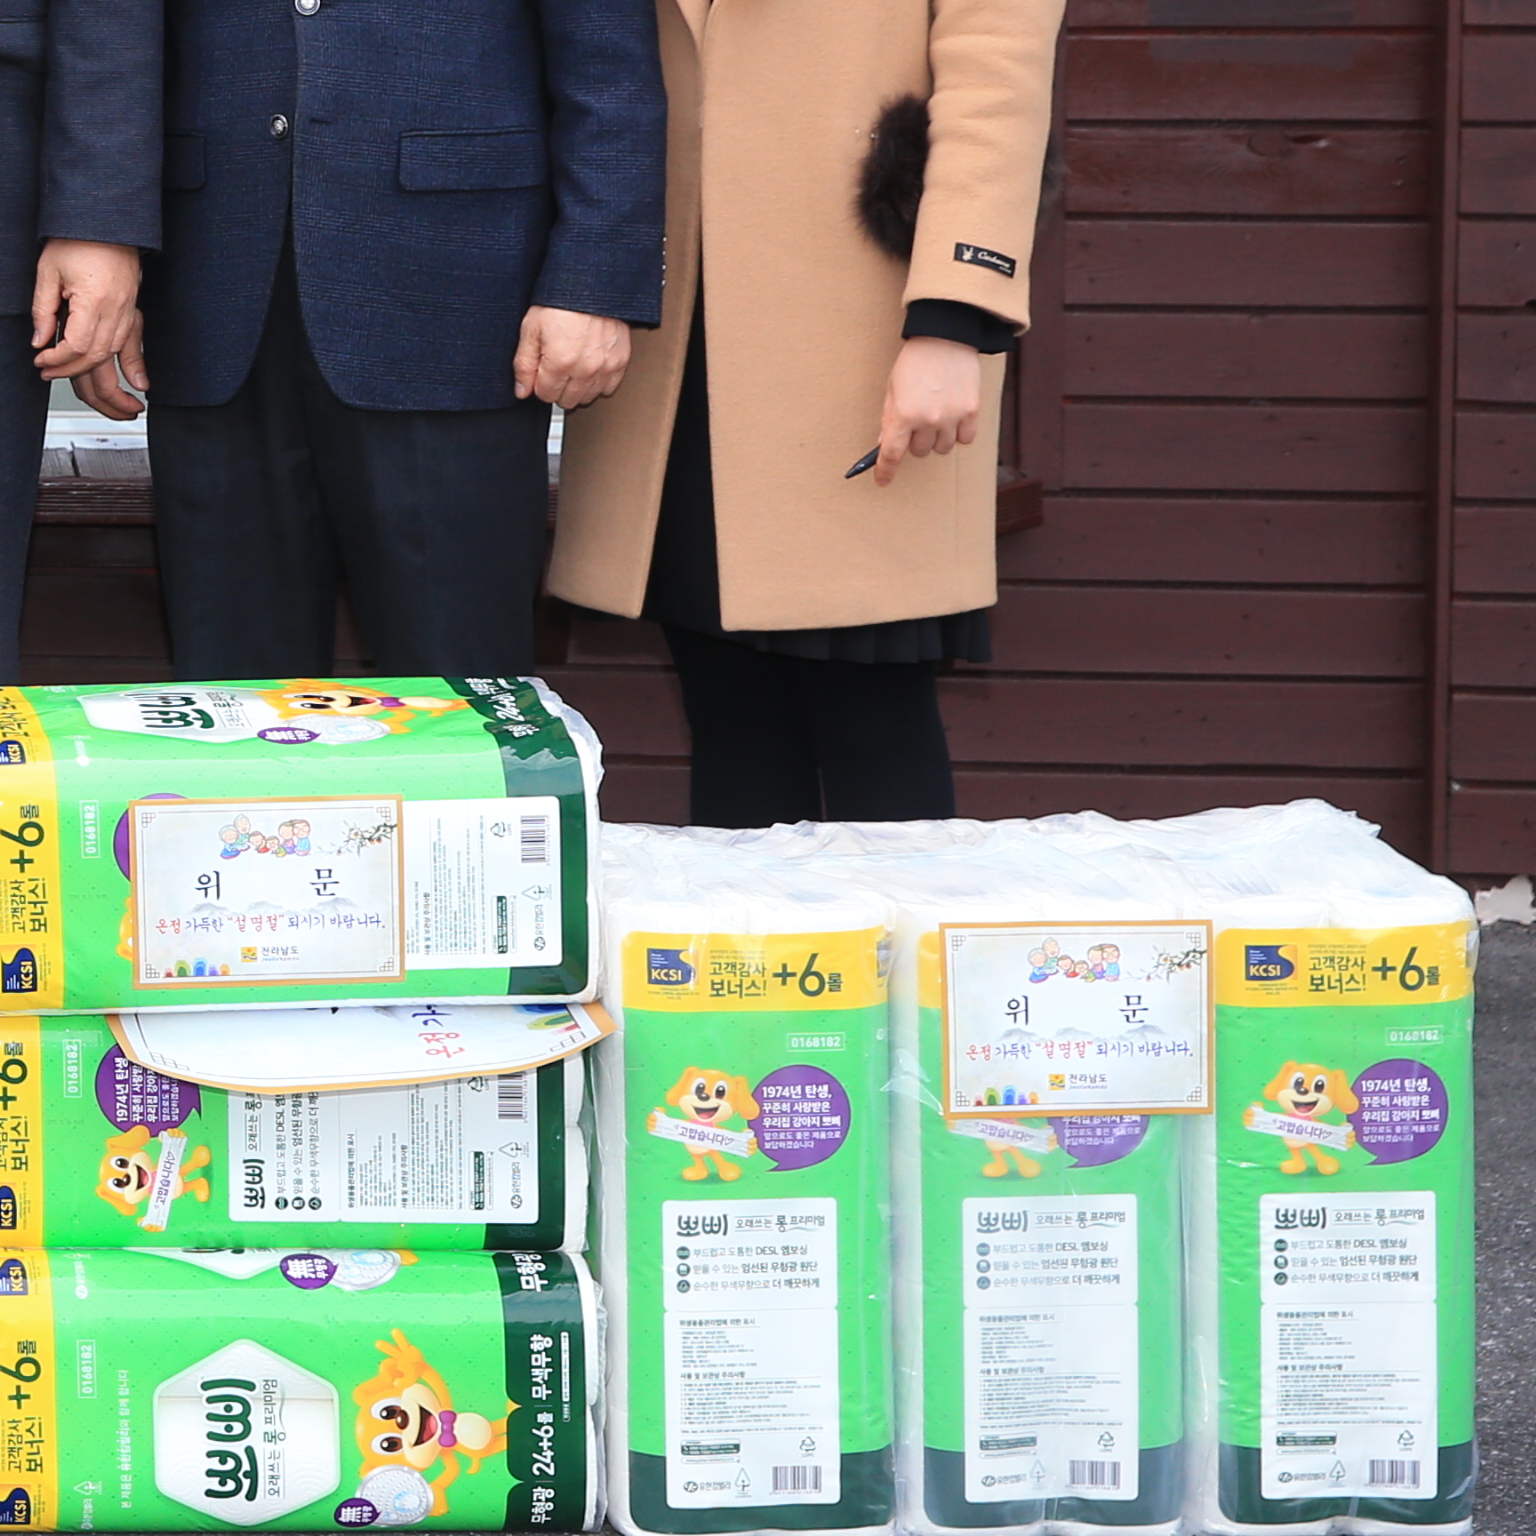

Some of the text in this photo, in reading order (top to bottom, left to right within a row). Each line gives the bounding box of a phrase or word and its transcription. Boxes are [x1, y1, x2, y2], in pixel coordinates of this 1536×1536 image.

[86, 805, 96, 854] 0168182
[195, 868, 339, 900] 위 문
[12, 880, 26, 934] 고객감사
[29, 878, 48, 934] 보너스!
[22, 961, 32, 990] KCSI
[651, 969, 682, 981] KCSI
[709, 962, 767, 978] 고객감사
[1249, 965, 1280, 977] KCSI
[1308, 956, 1366, 971] 고객감사
[709, 980, 767, 998] 보너스!
[1308, 974, 1366, 993] 보너스!
[1004, 994, 1148, 1026] 위 문
[791, 1036, 841, 1048] 0168182
[67, 1044, 78, 1093] 0168182
[762, 1086, 803, 1099] 1974년
[10, 1116, 29, 1171] 보너스!
[1, 1198, 13, 1226] KCSI
[735, 1218, 773, 1229] 오래쓰는
[775, 1215, 788, 1232] 롱
[790, 1215, 825, 1226] 프리미엄
[82, 1345, 93, 1394] 0168182
[201, 1378, 258, 1501] 뽀삐
[263, 1379, 286, 1497] 오래쓰는 롱 프리미엄
[530, 1334, 555, 1524] 무형광 24+6롤 무색무향
[8, 1419, 22, 1473] 고객감사
[25, 1417, 44, 1474] 보너스!
[16, 1499, 27, 1523] KCSI
